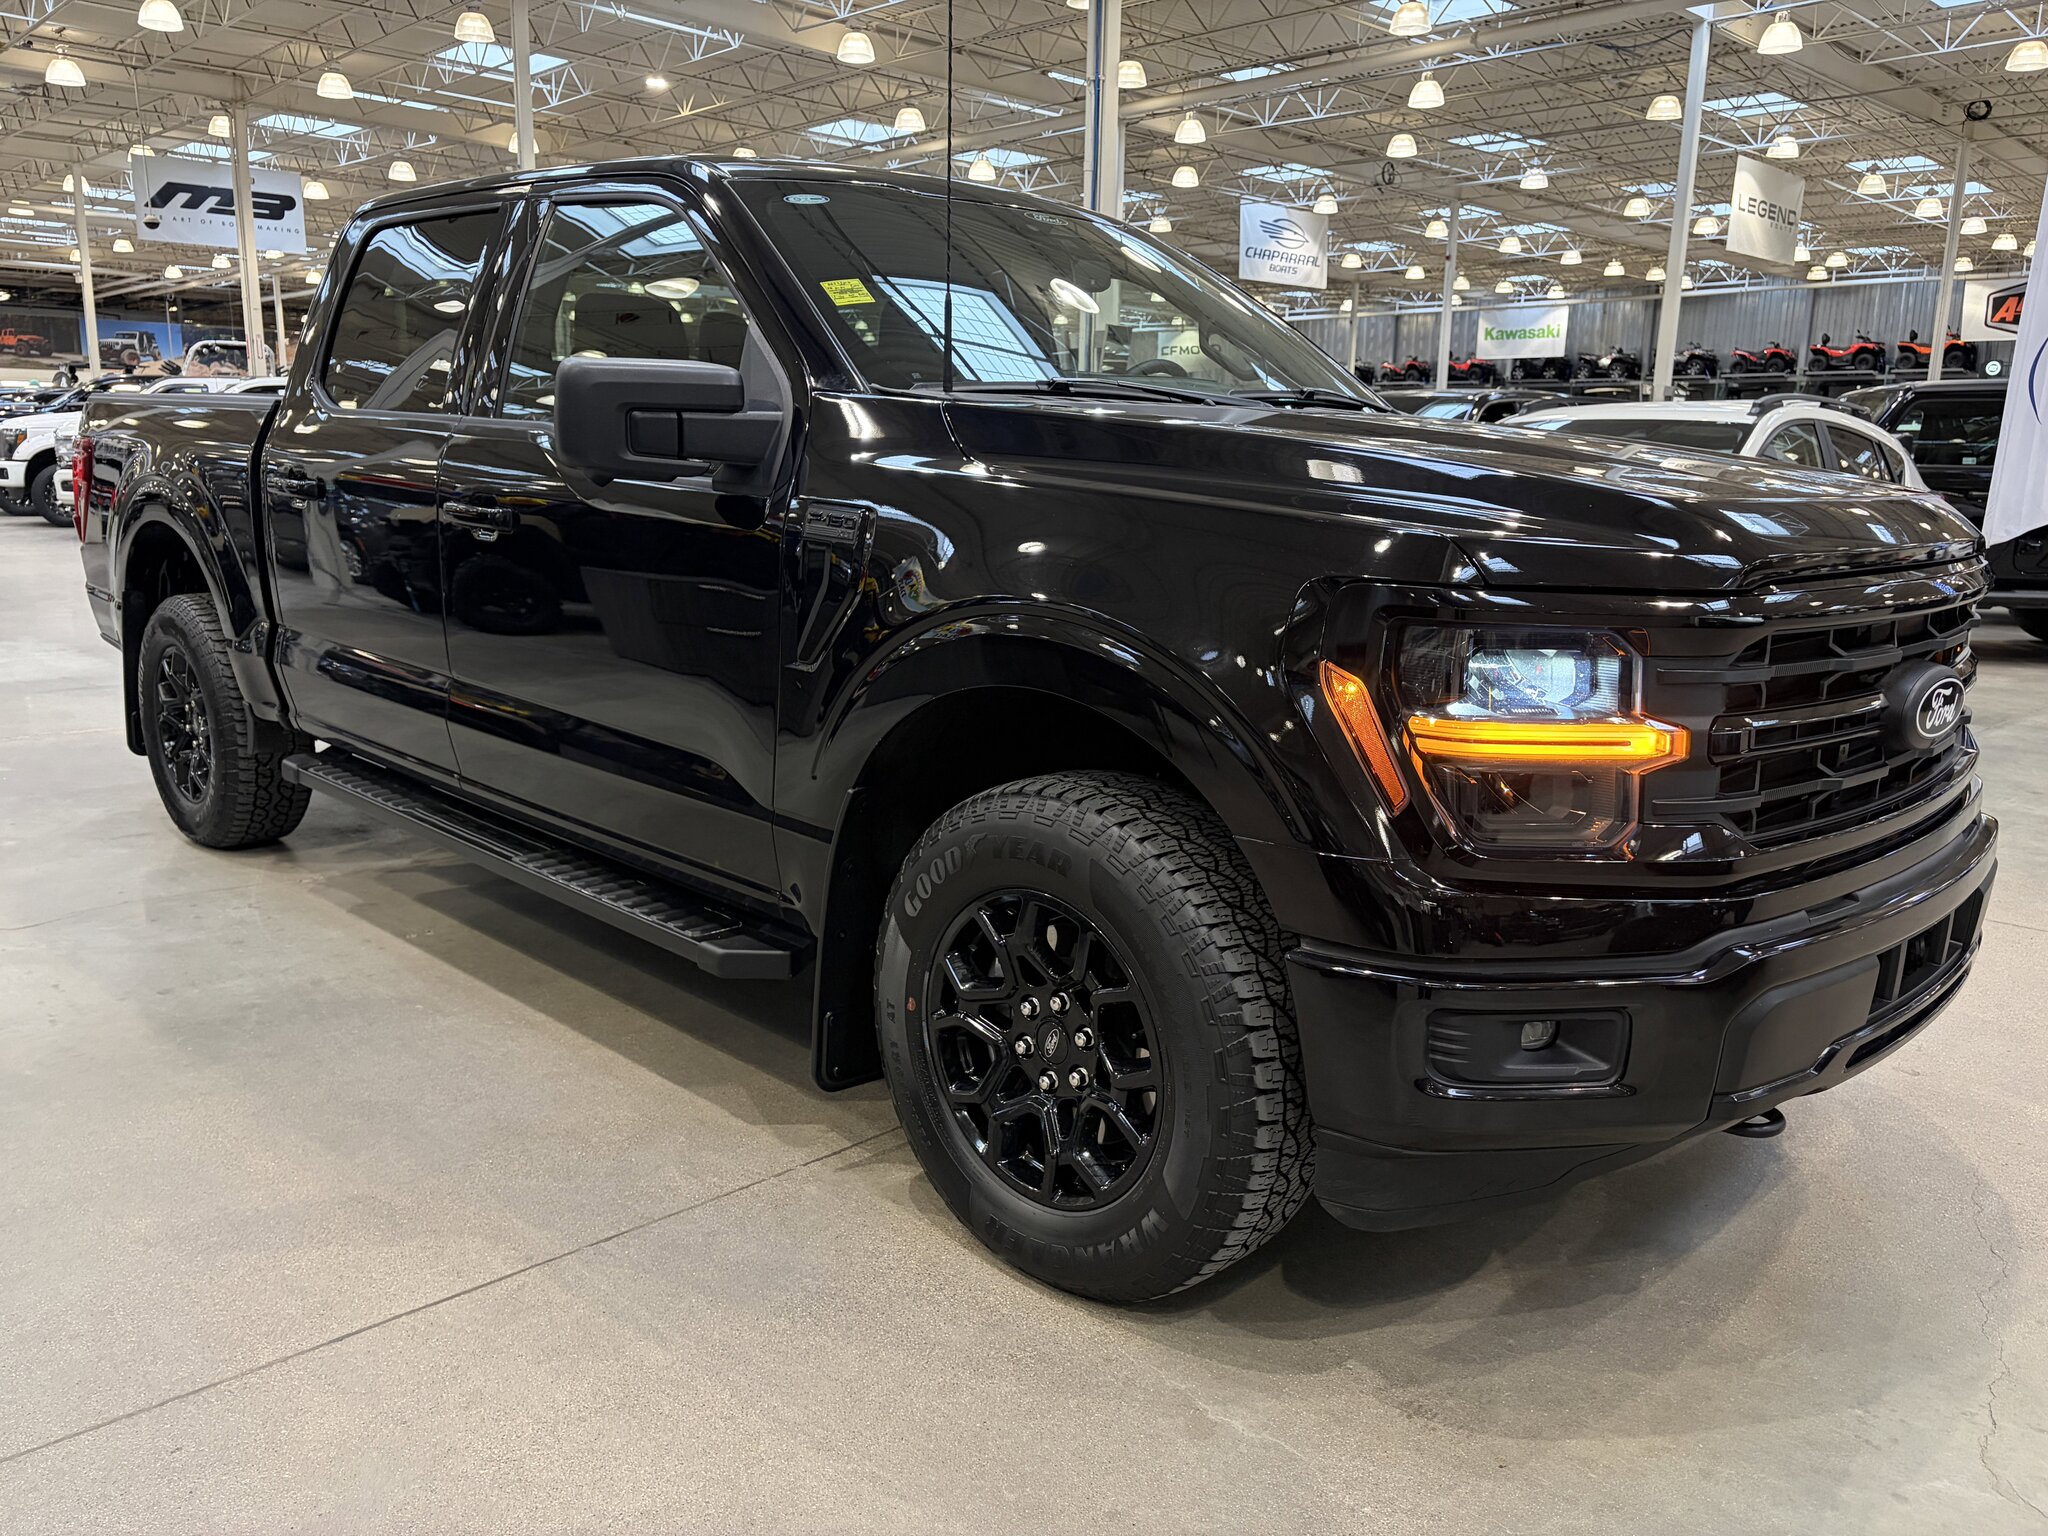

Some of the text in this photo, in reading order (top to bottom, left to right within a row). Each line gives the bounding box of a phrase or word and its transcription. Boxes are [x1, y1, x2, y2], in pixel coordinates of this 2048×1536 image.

[1737, 193, 1797, 226] LEGEND
[1245, 246, 1321, 268] CHAPARRAL
[1268, 263, 1298, 275] BOATS
[1484, 324, 1561, 341] Kawasaki
[1926, 686, 1959, 729] Ford
